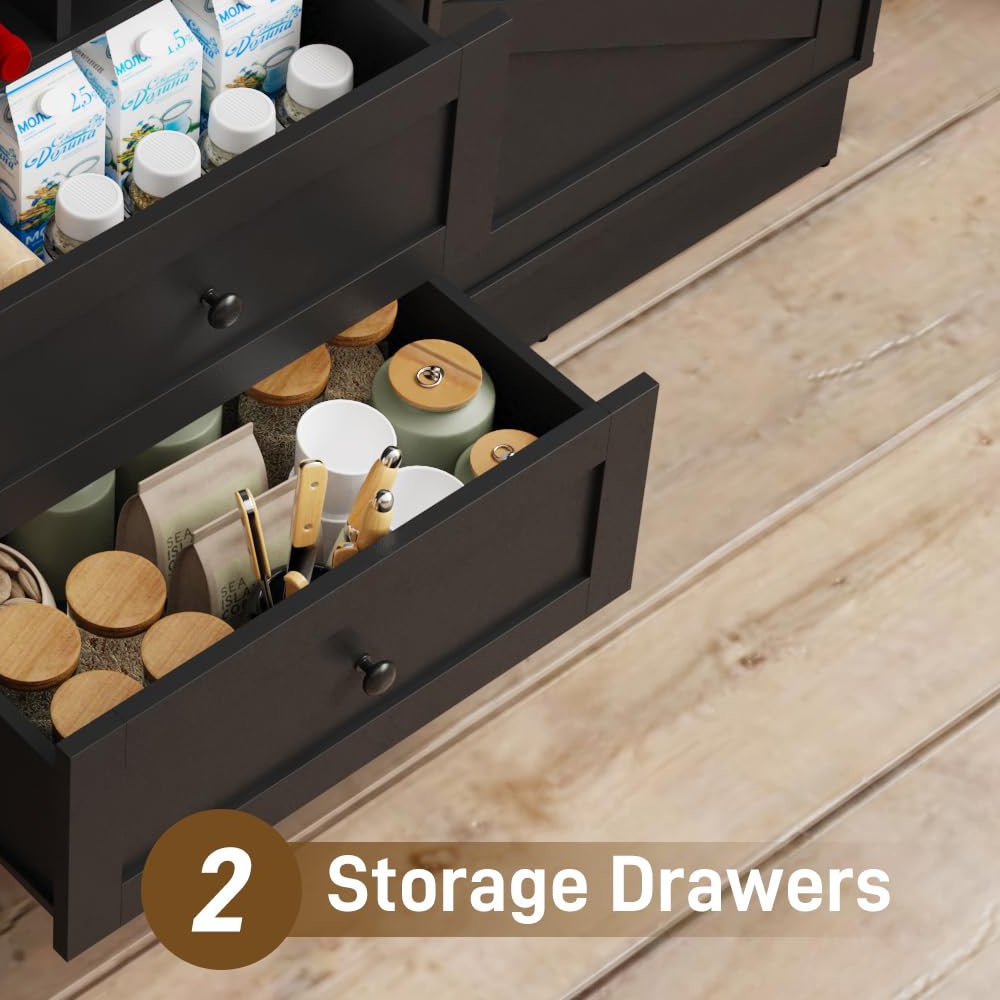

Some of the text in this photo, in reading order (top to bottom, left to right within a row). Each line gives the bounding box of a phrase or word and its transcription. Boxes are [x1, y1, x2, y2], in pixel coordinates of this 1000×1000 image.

[218, 1, 253, 24] МОЛ
[17, 111, 53, 135] МОЛ
[167, 527, 194, 550] SEA
[220, 577, 248, 599] SEA
